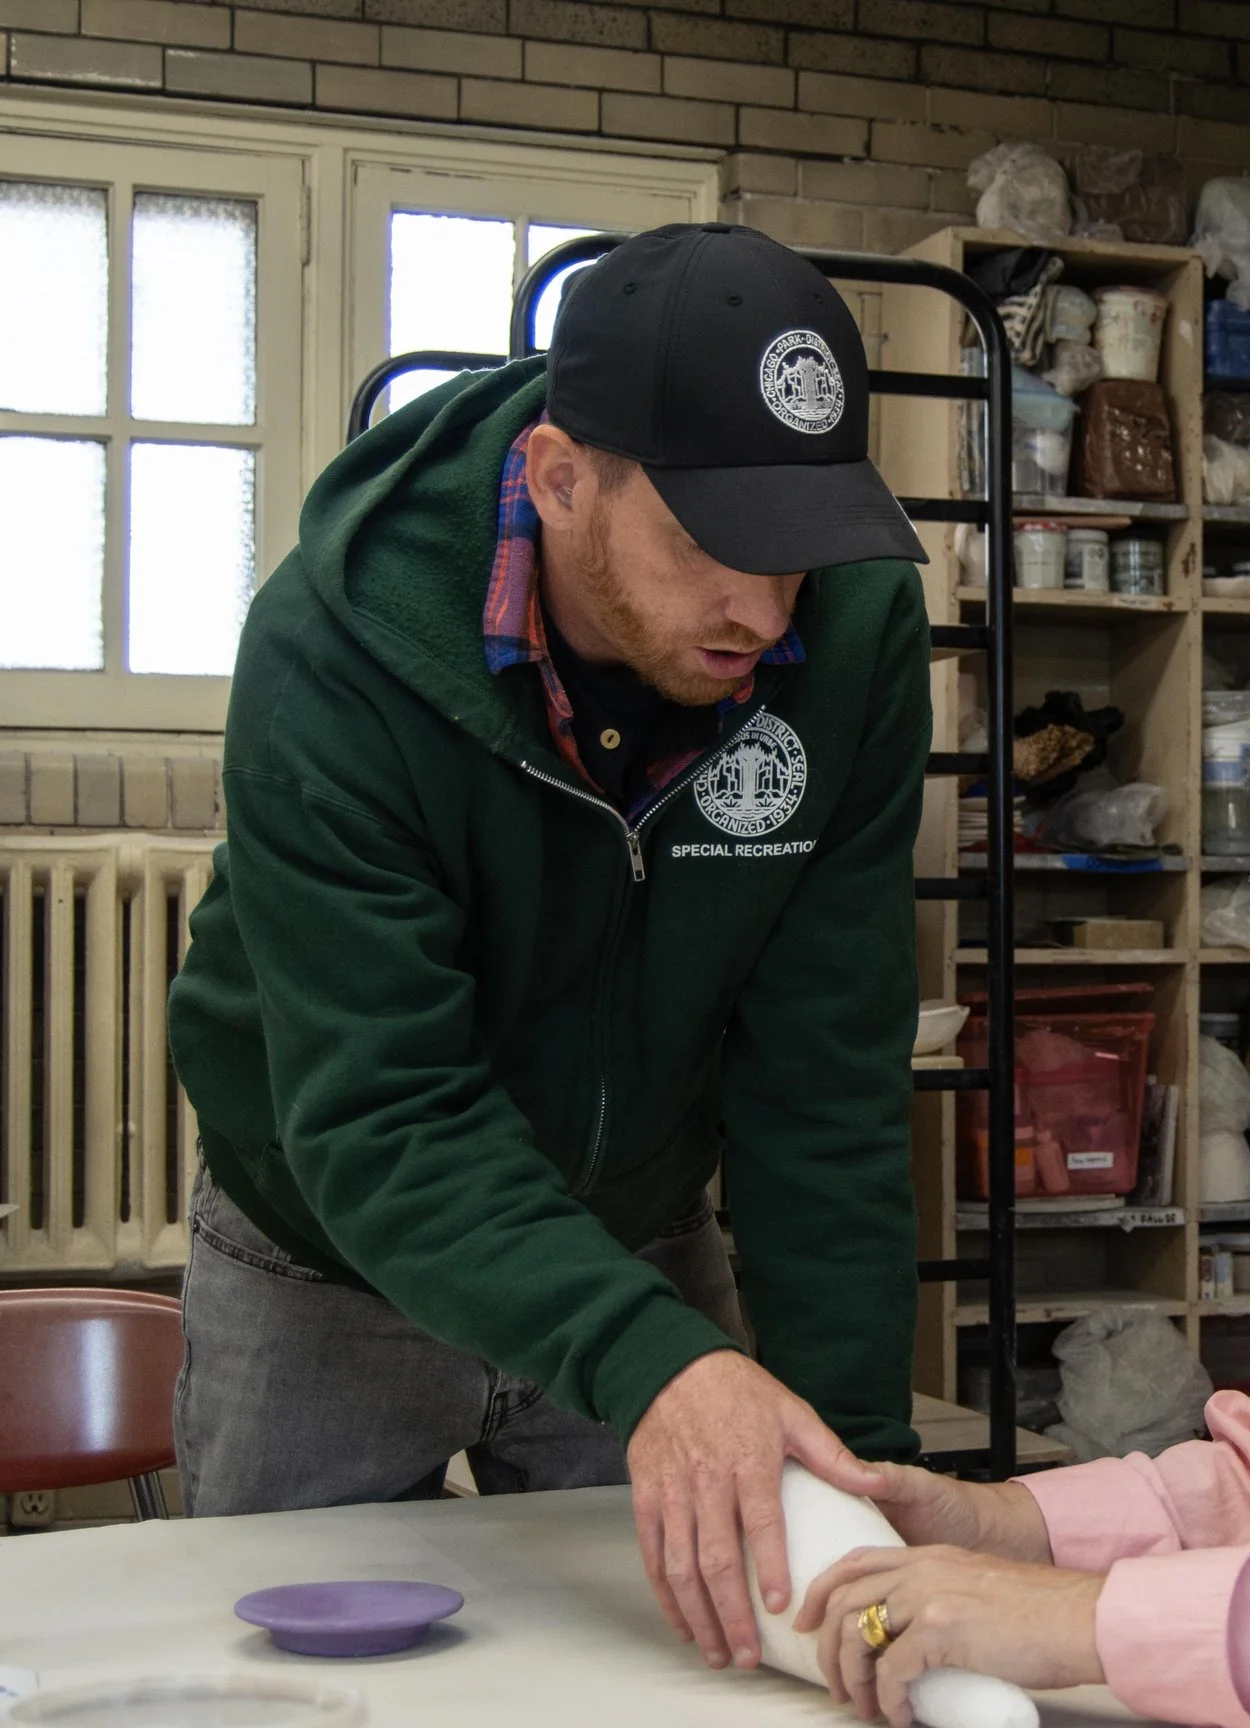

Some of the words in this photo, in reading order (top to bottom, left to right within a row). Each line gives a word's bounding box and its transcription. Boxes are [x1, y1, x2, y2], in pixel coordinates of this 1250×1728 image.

[763, 353, 779, 398] CHICAGO
[777, 334, 802, 353] PARK
[773, 401, 828, 431] ORGANIZED
[756, 715, 798, 752] DISTRICT
[791, 755, 805, 790] SEAL
[700, 797, 766, 834] ORGANIZED
[770, 795, 798, 826] 1934
[671, 843, 733, 858] SPECIAL
